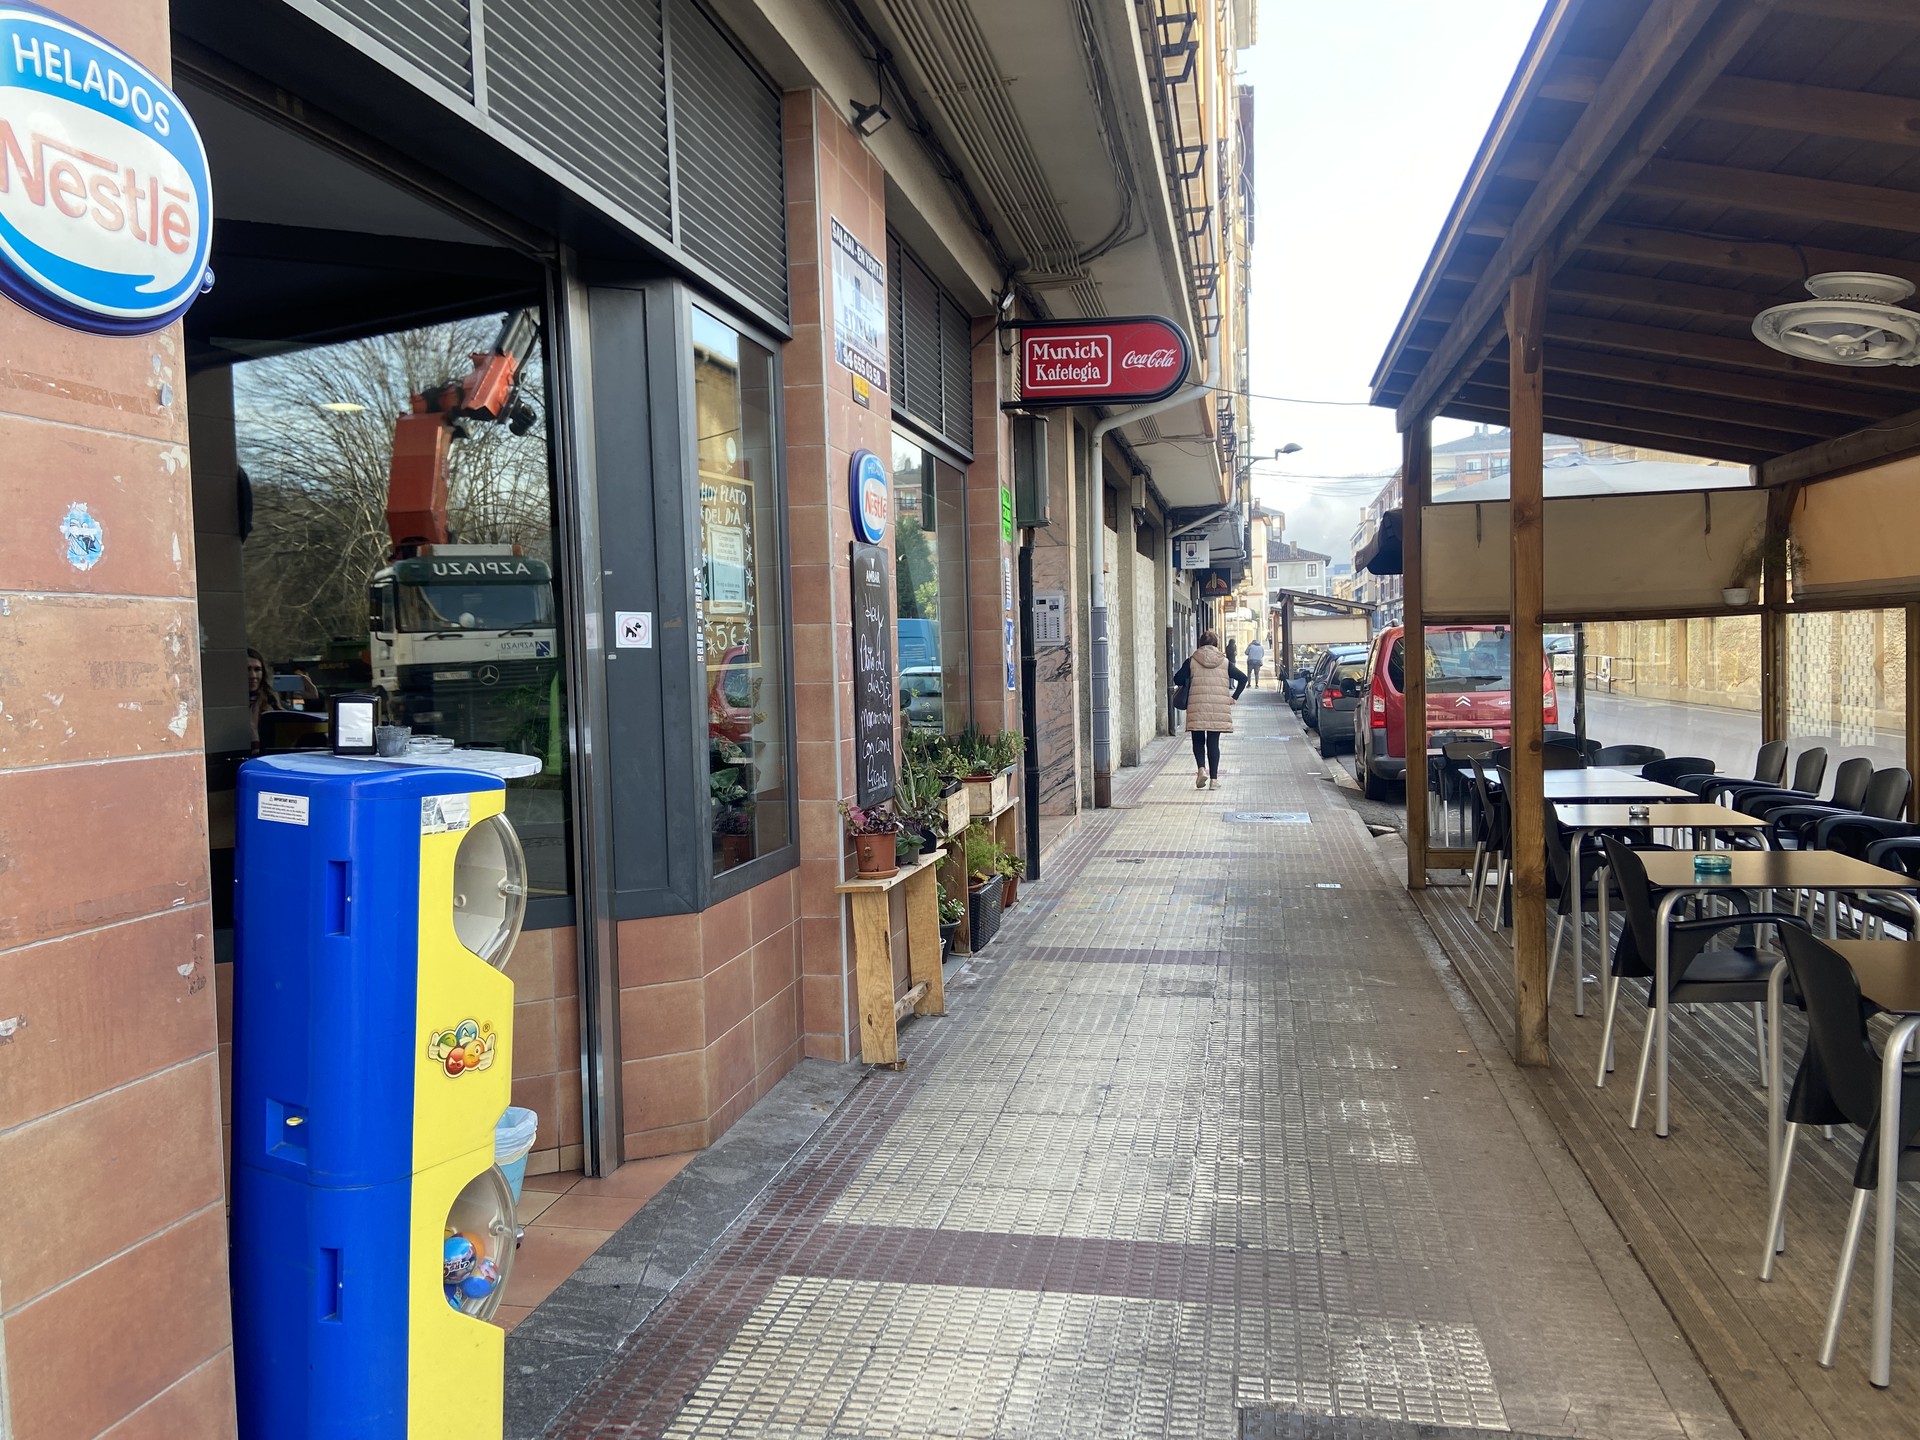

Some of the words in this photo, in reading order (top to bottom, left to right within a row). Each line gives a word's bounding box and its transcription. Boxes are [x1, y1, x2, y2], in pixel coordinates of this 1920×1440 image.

[12, 33, 170, 137] HELADOS
[0, 119, 191, 255] Nestlé
[1032, 341, 1104, 361] Munich
[1121, 349, 1177, 369] Coca-Cola
[1036, 362, 1101, 383] Kafetegia
[701, 482, 718, 506] HOY
[720, 484, 747, 506] PLATO
[705, 507, 722, 525] DEL
